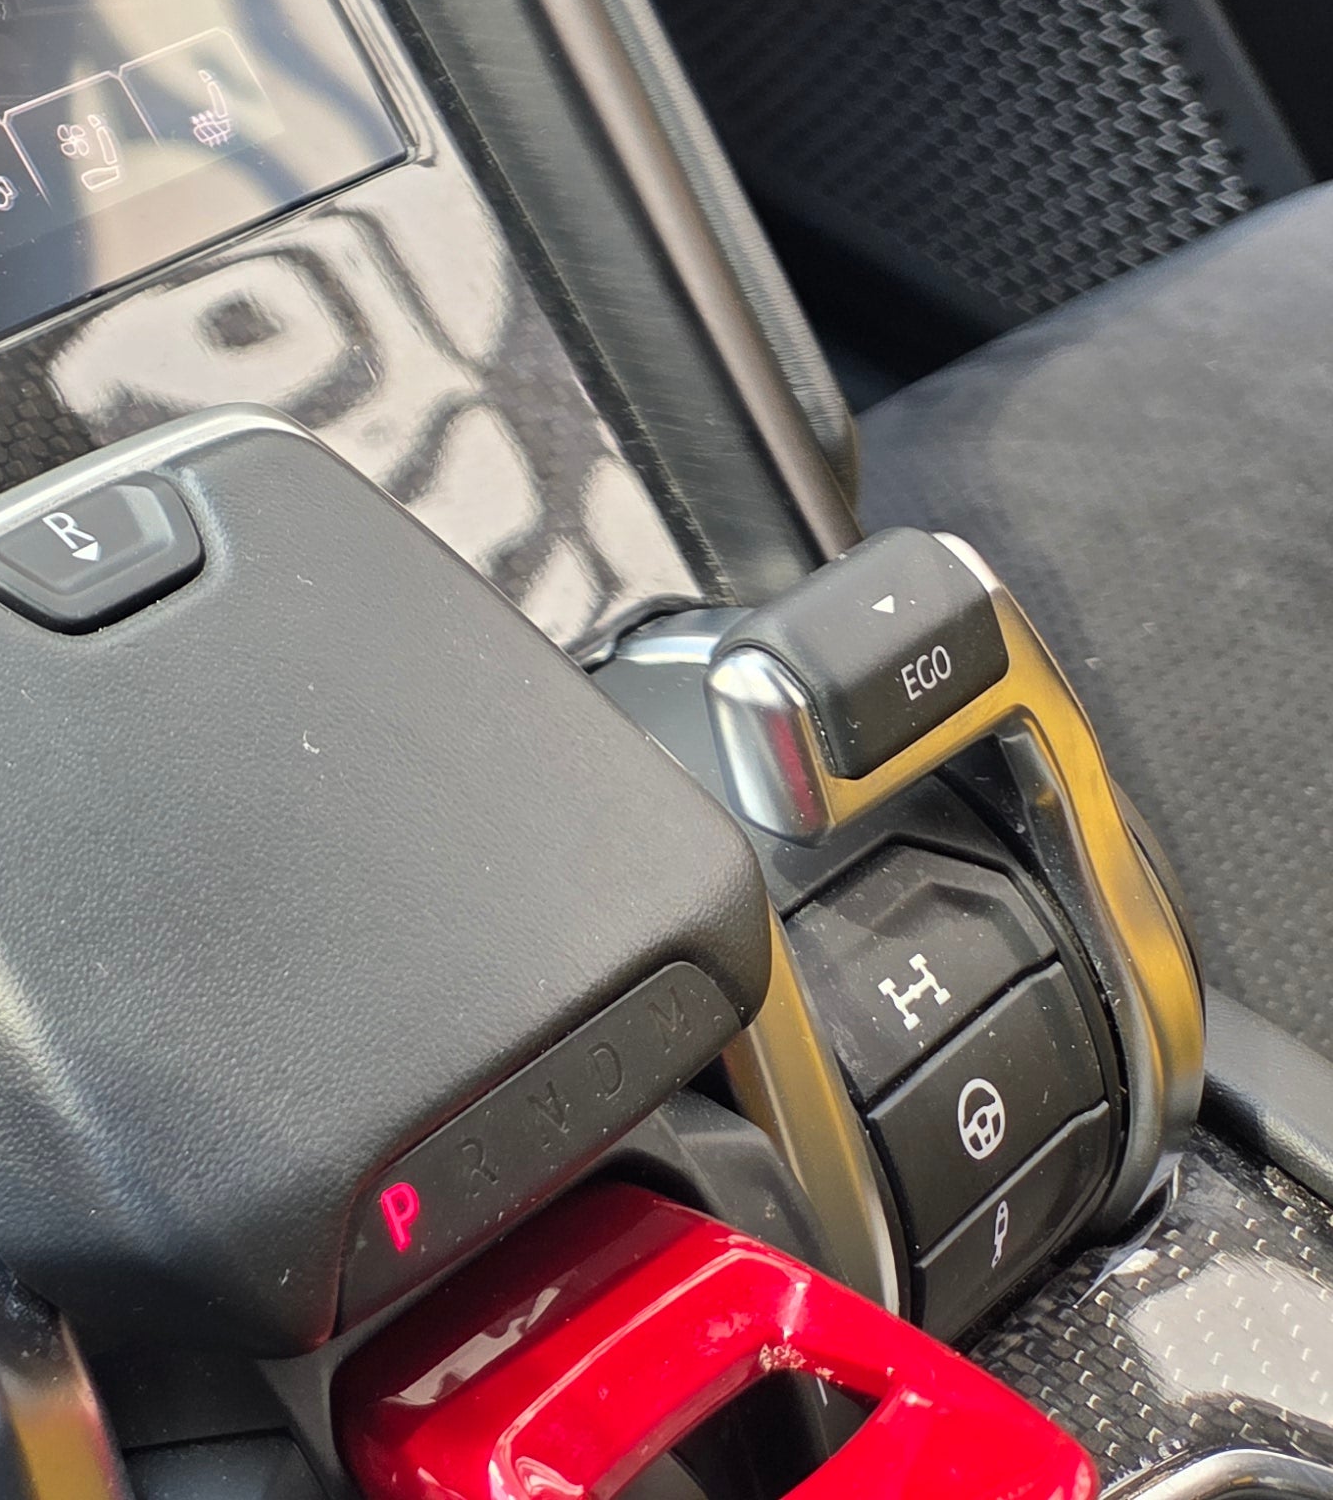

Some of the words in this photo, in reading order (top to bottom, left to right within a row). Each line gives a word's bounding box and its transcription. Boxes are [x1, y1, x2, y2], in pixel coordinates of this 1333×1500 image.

[42, 512, 97, 551] R
[900, 645, 952, 701] EGO
[379, 1181, 421, 1252] P
